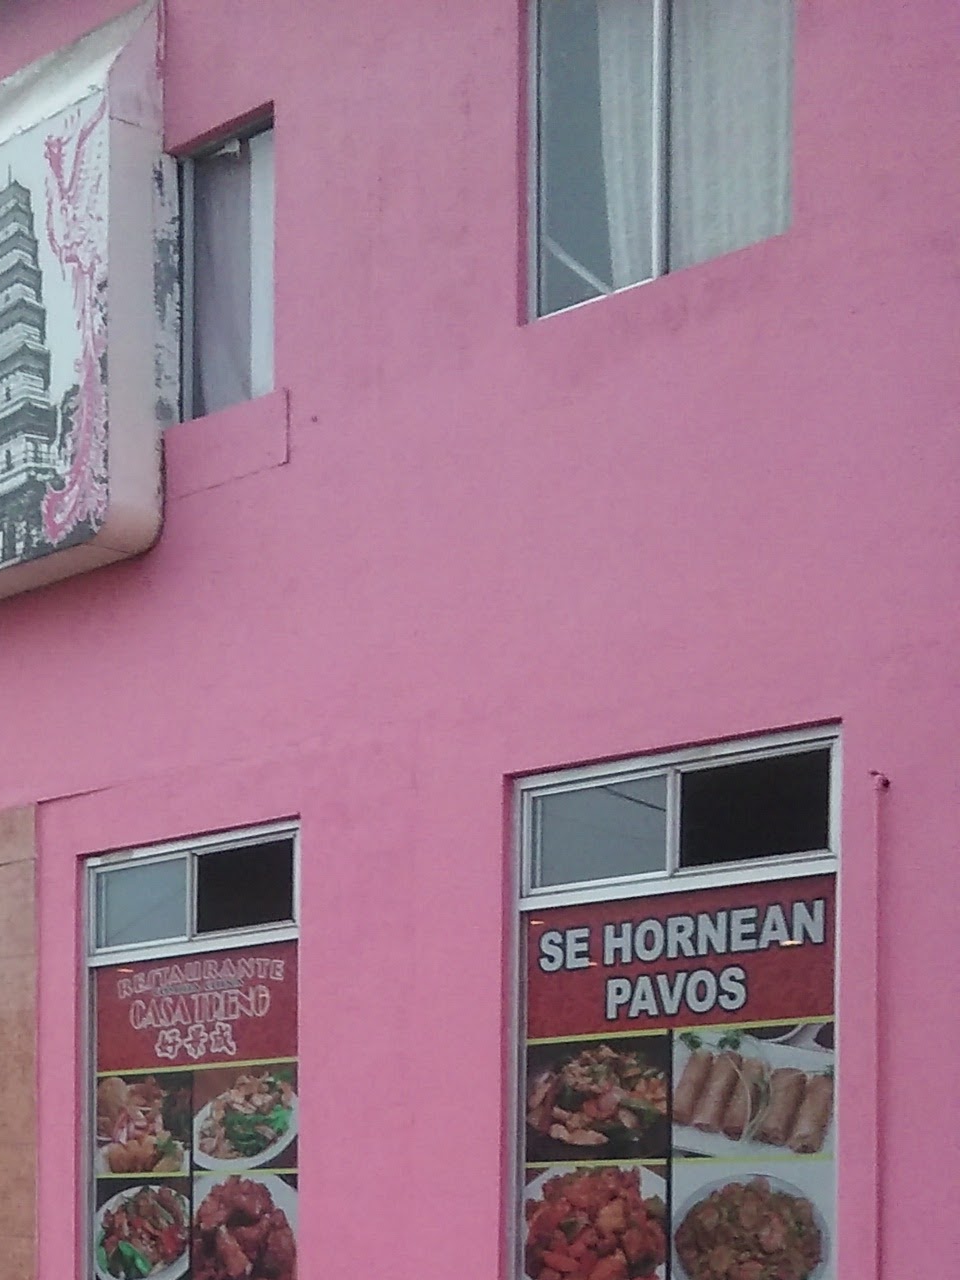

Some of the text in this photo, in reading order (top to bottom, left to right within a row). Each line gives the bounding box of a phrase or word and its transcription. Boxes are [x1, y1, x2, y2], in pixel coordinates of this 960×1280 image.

[539, 898, 825, 973] SE HORNEAN
[117, 958, 284, 999] RESTAURANTE
[605, 966, 747, 1020] PAVOS
[129, 995, 192, 1030] CASA
